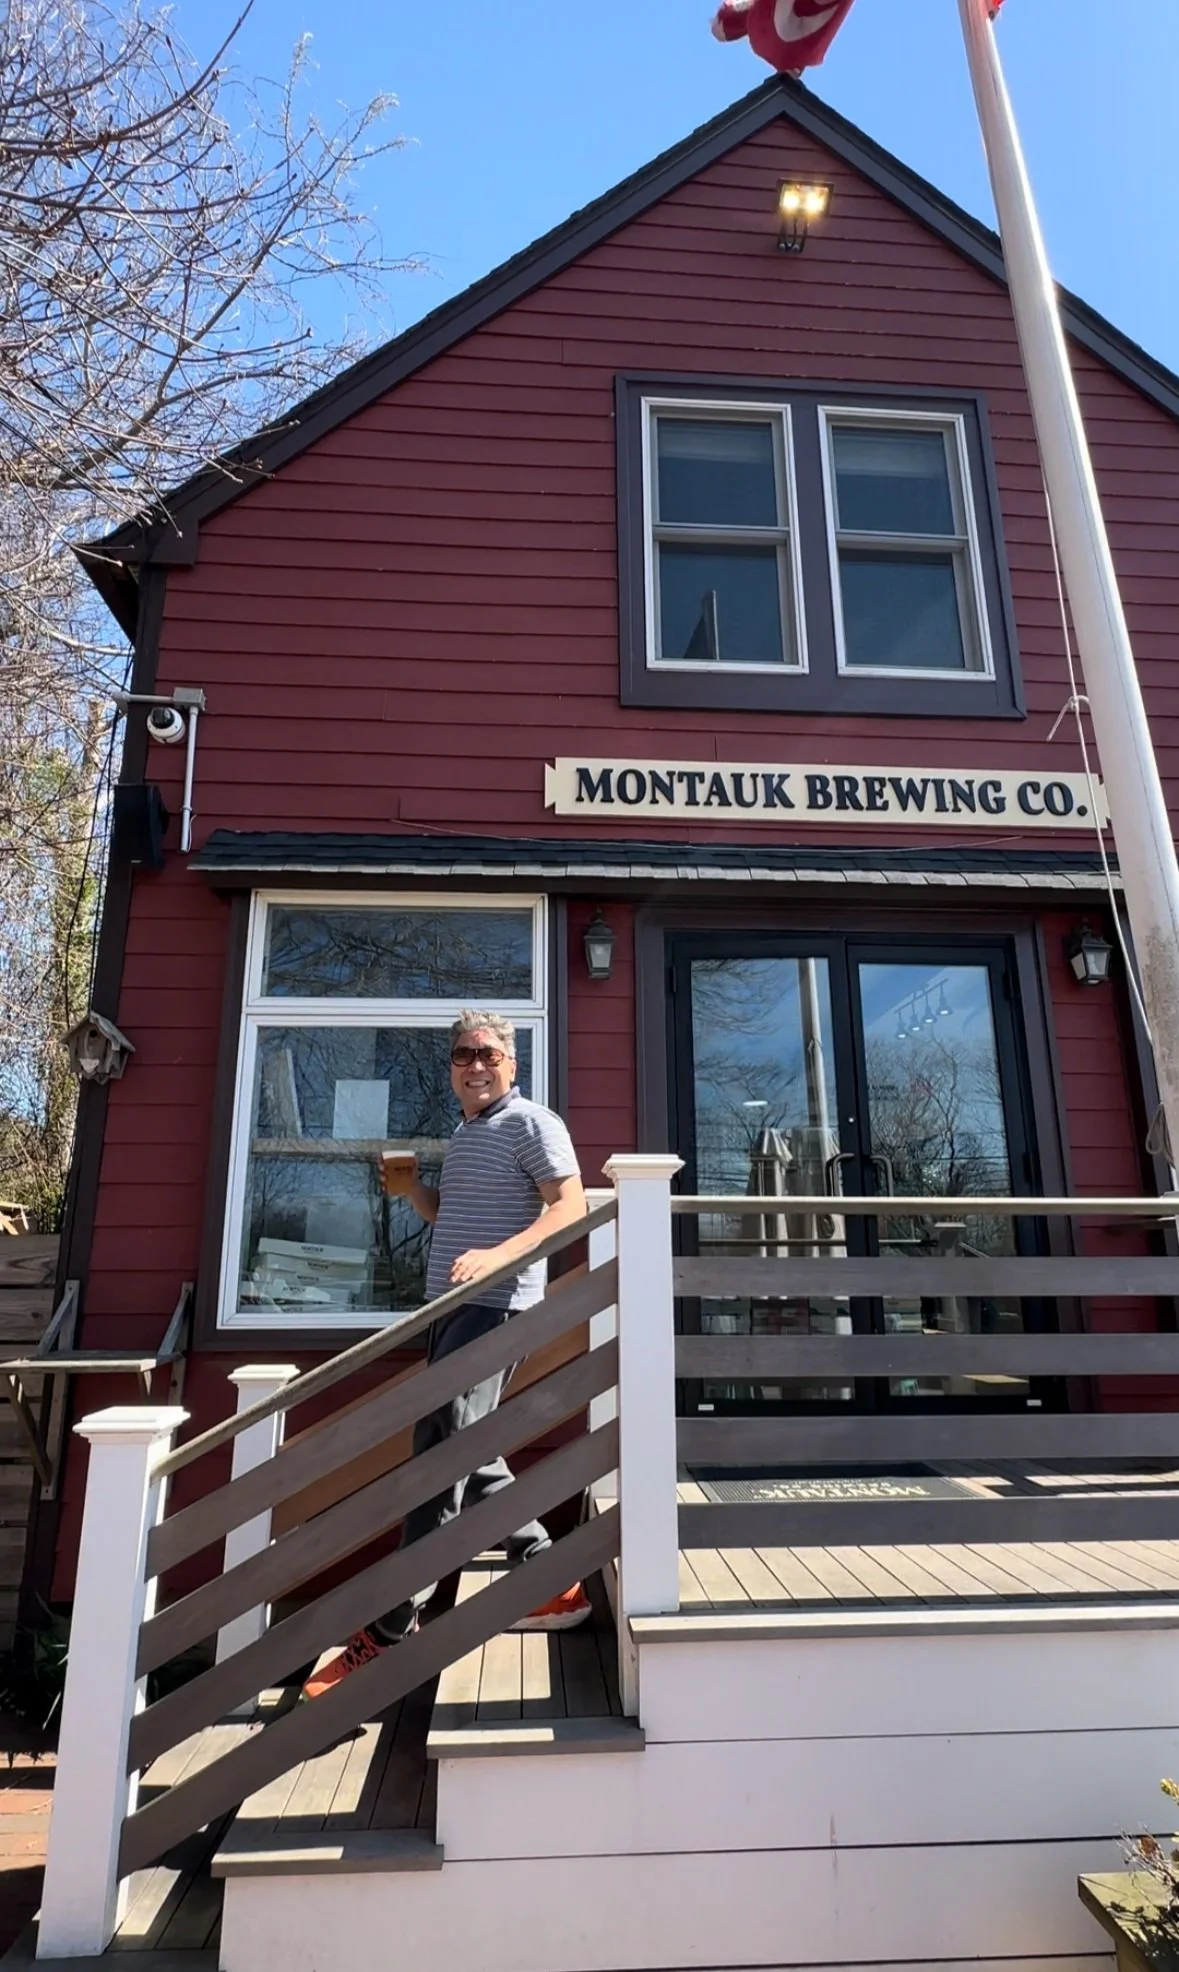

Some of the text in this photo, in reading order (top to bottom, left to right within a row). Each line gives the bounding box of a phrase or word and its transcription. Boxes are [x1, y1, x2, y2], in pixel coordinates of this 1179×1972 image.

[575, 767, 1089, 817] MONTAUK BREWING CO.
